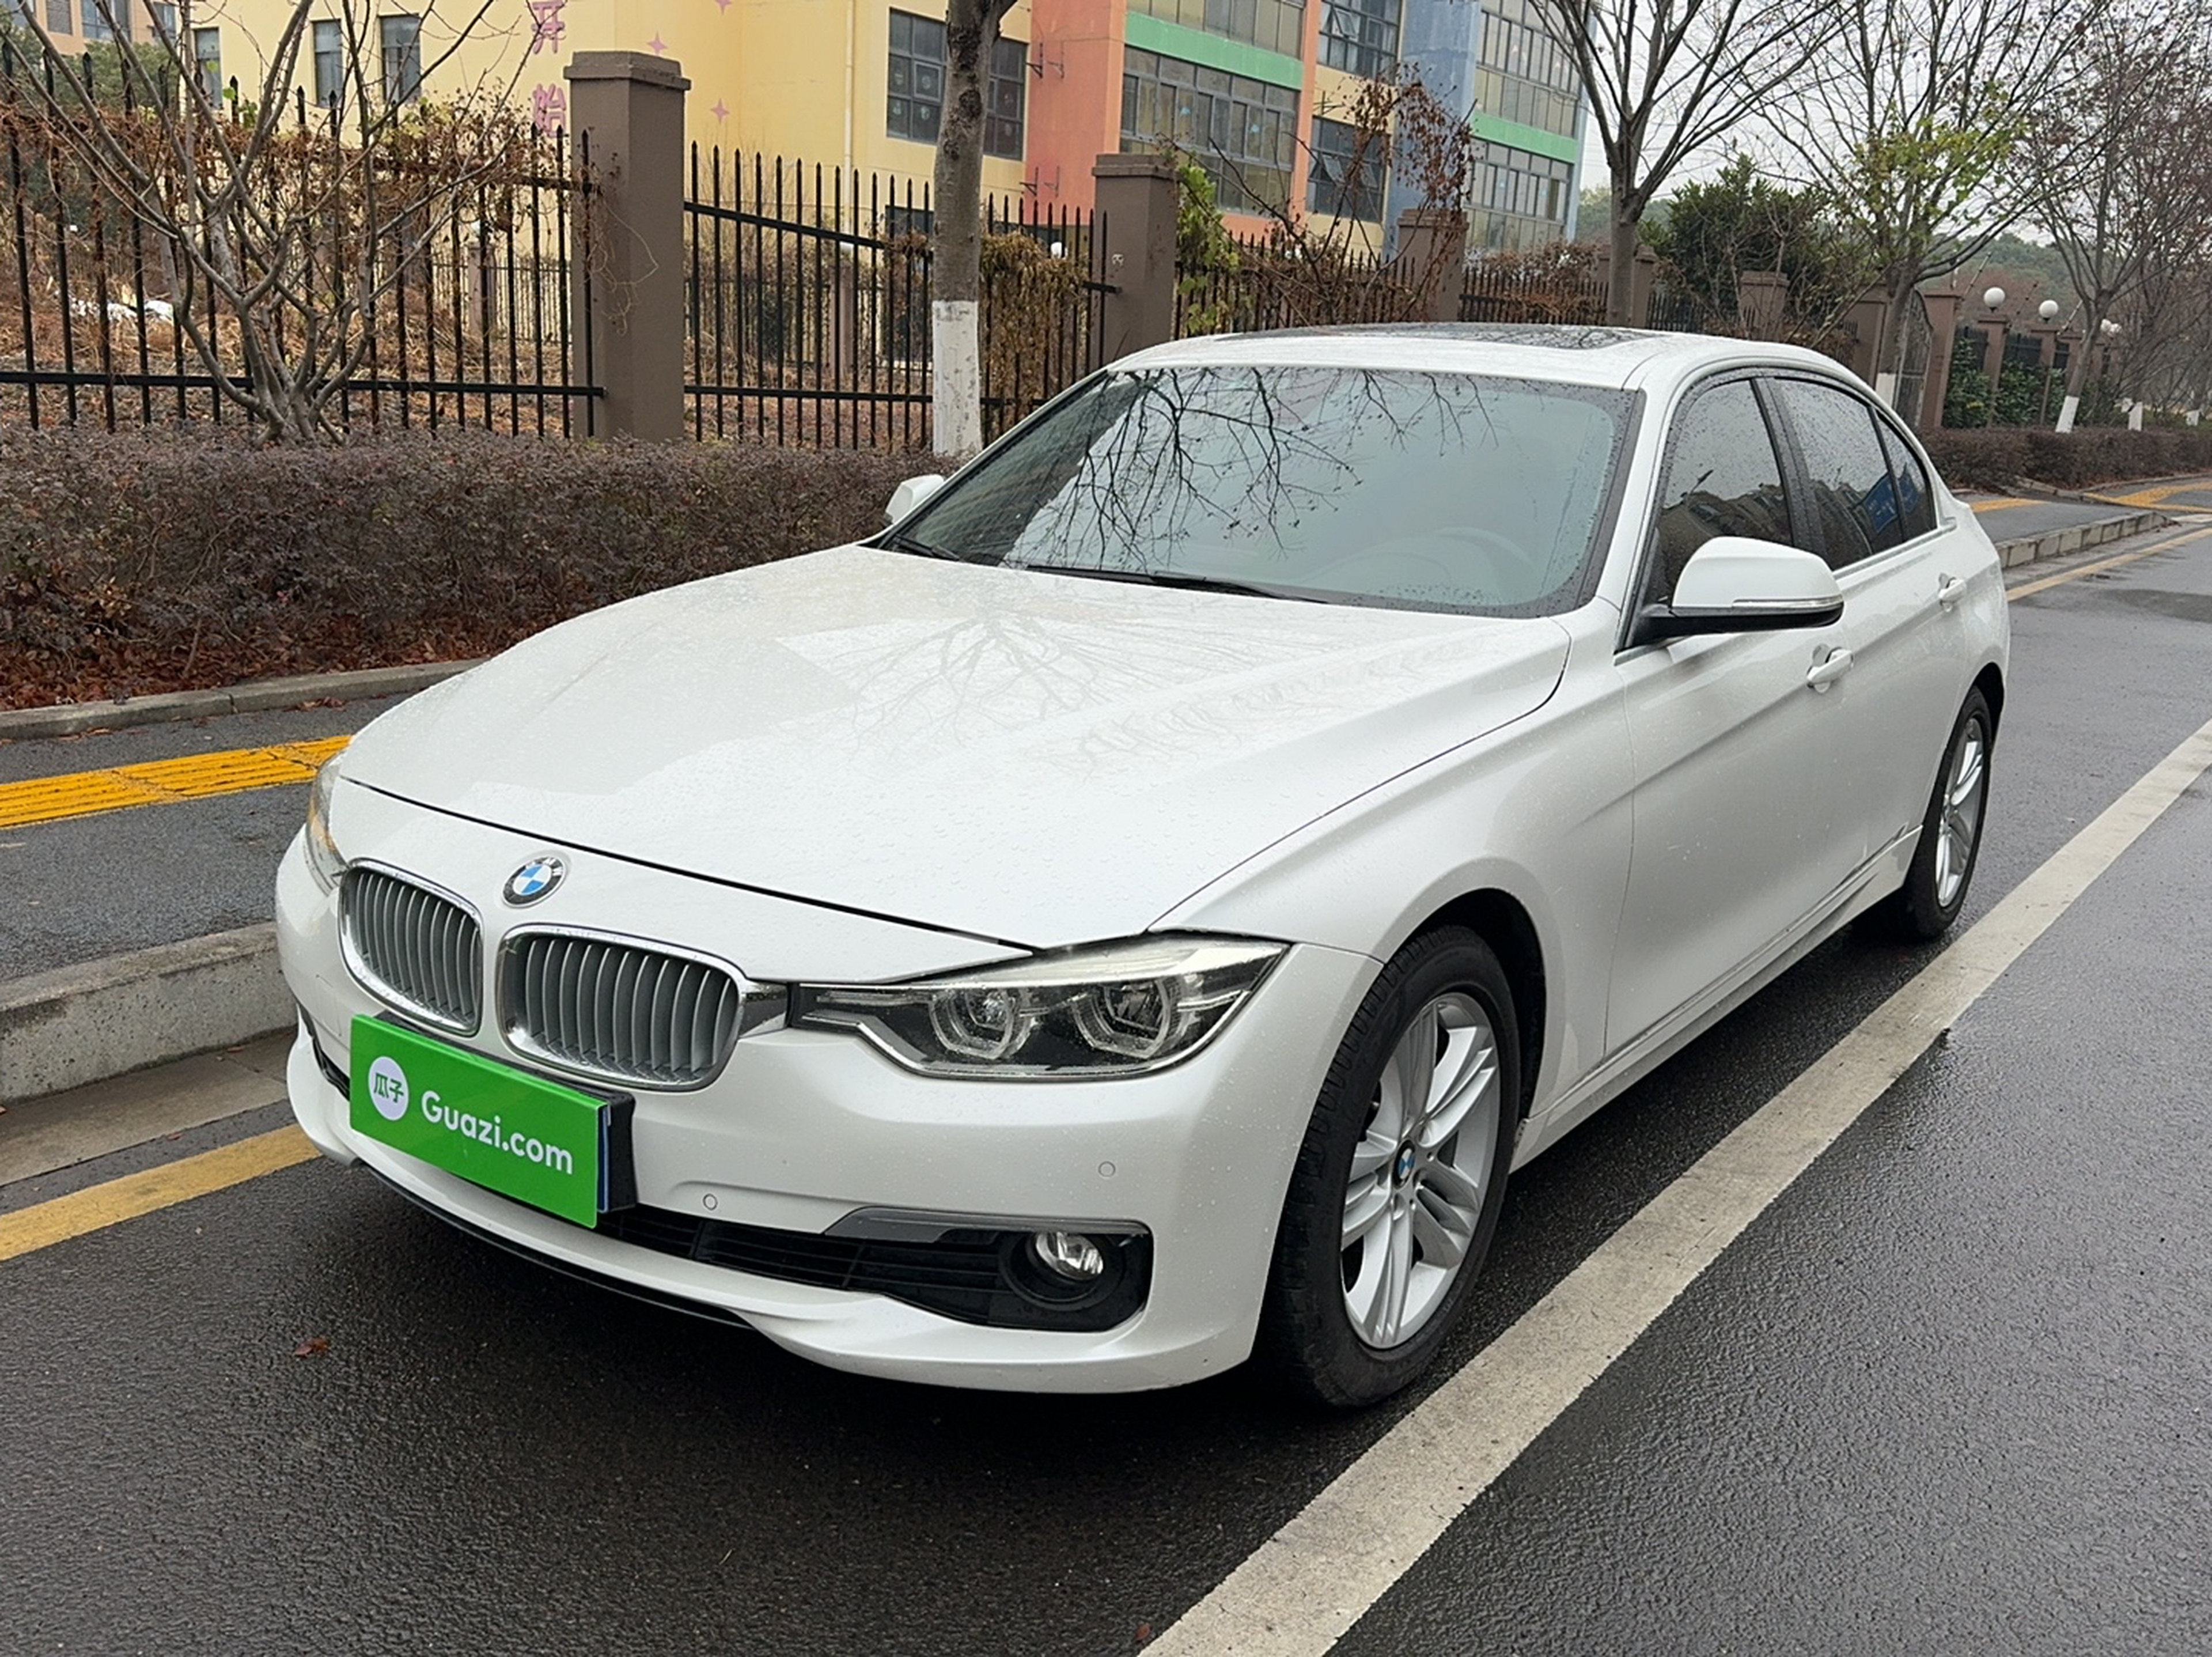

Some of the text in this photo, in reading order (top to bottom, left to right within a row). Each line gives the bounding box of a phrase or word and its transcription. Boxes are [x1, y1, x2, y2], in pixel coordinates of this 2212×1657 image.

[531, 1, 567, 138] 开始
[374, 1072, 404, 1103] 瓜子
[421, 1090, 573, 1175] Guazi.com
